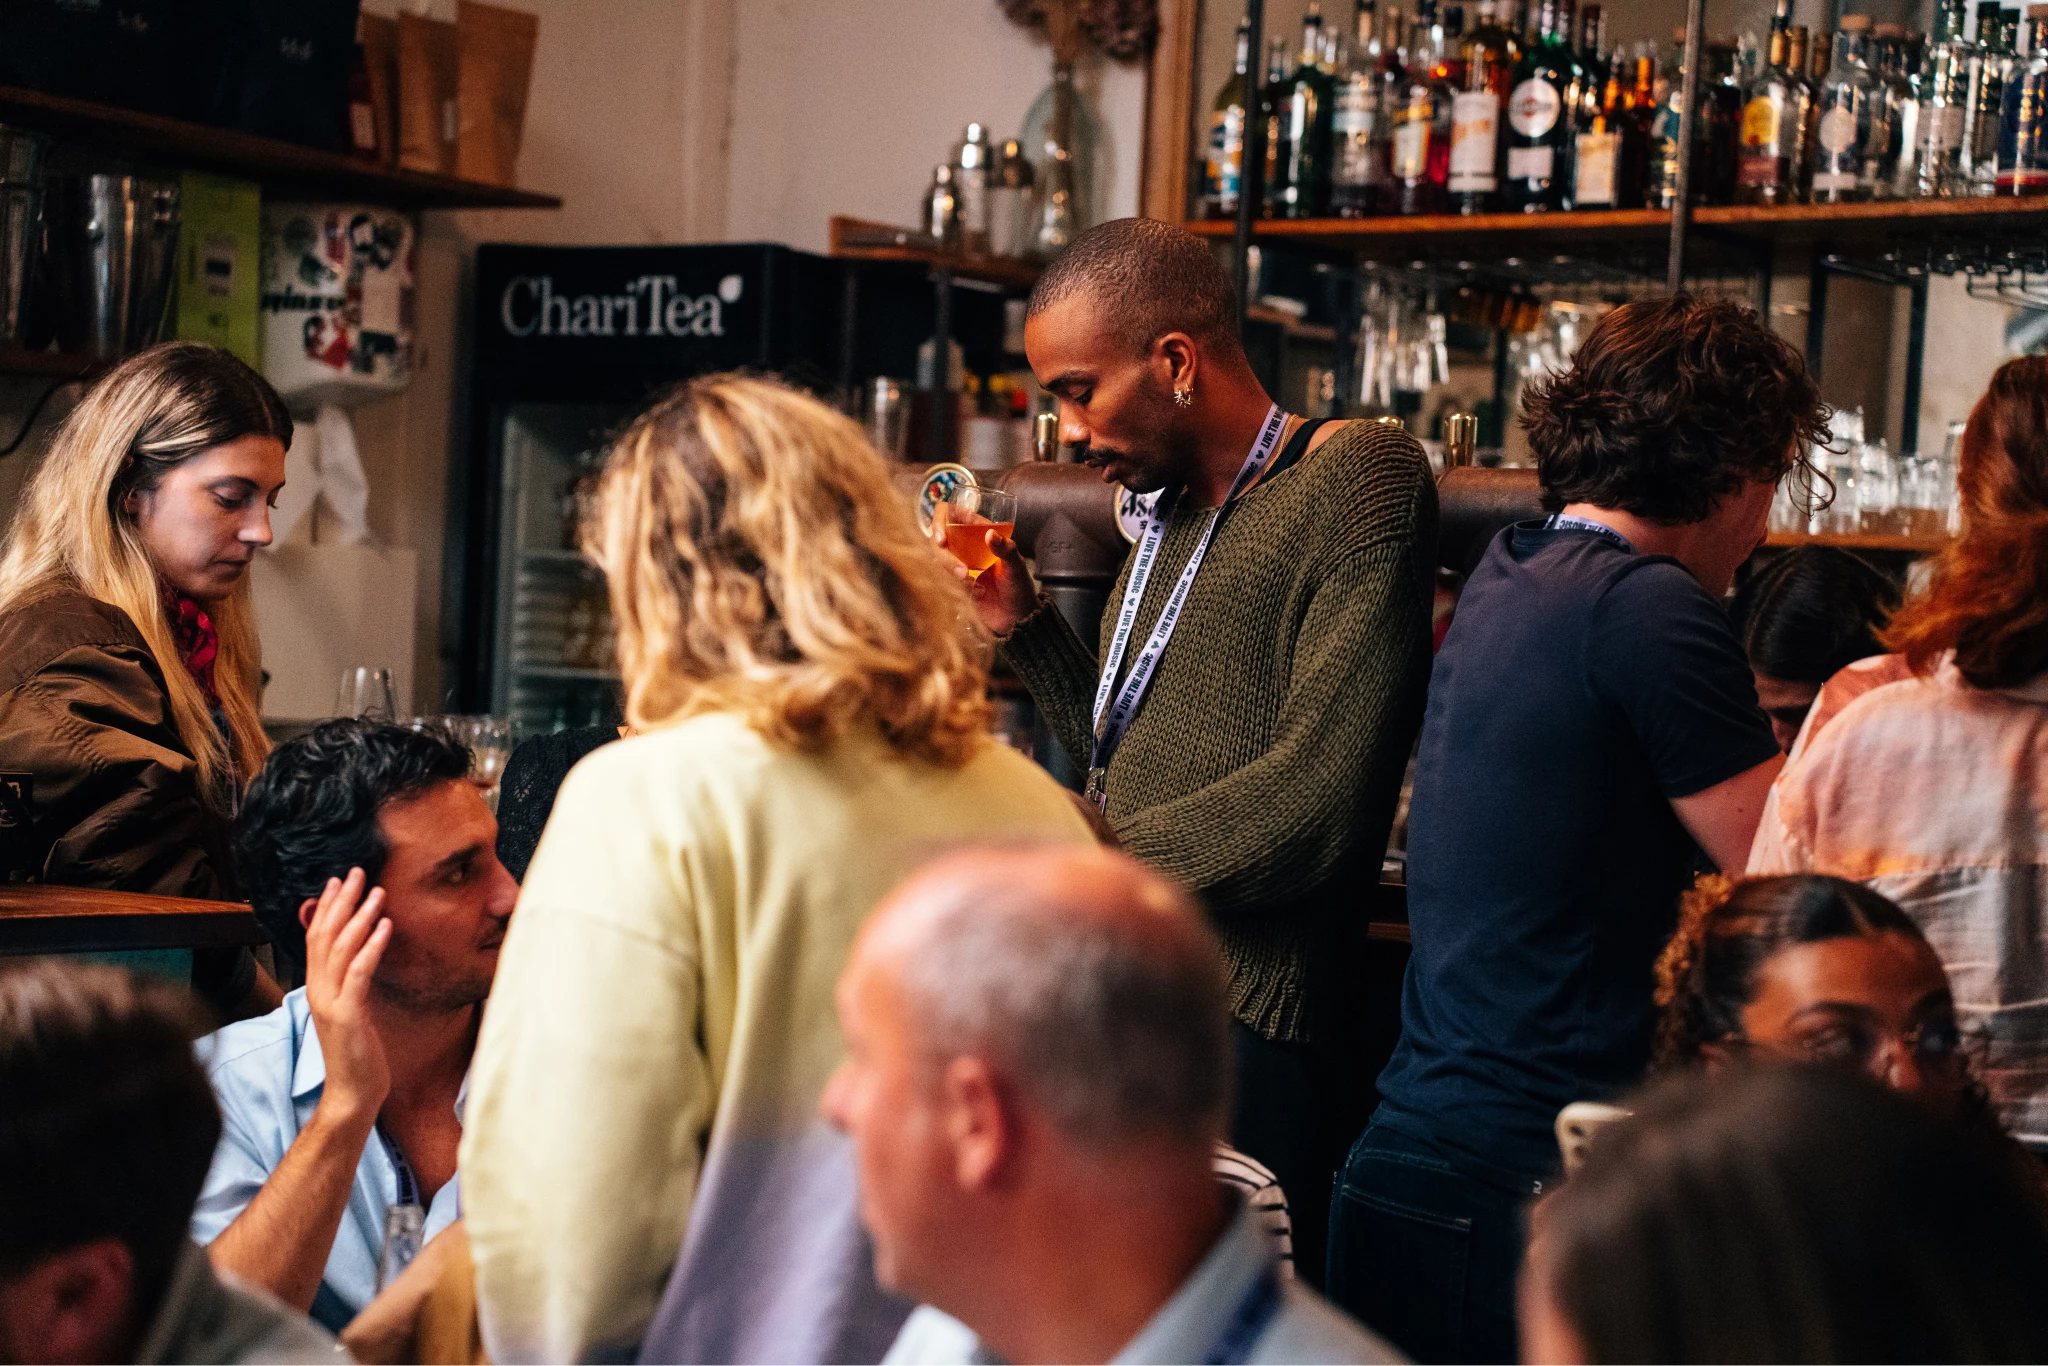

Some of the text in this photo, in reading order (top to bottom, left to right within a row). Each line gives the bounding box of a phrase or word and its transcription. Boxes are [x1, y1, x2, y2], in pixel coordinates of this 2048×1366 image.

[501, 274, 725, 337] ChariTea
[1260, 431, 1275, 449] LIVE
[1267, 415, 1281, 433] THE
[1131, 536, 1157, 594] LIVE THE MUSIC
[1192, 548, 1203, 565] LIVE
[1157, 580, 1188, 639] LIVE THE MUSIC
[1109, 610, 1133, 668] LIVE THE MUSIC
[1119, 652, 1154, 711] LIVE THE MUSIC
